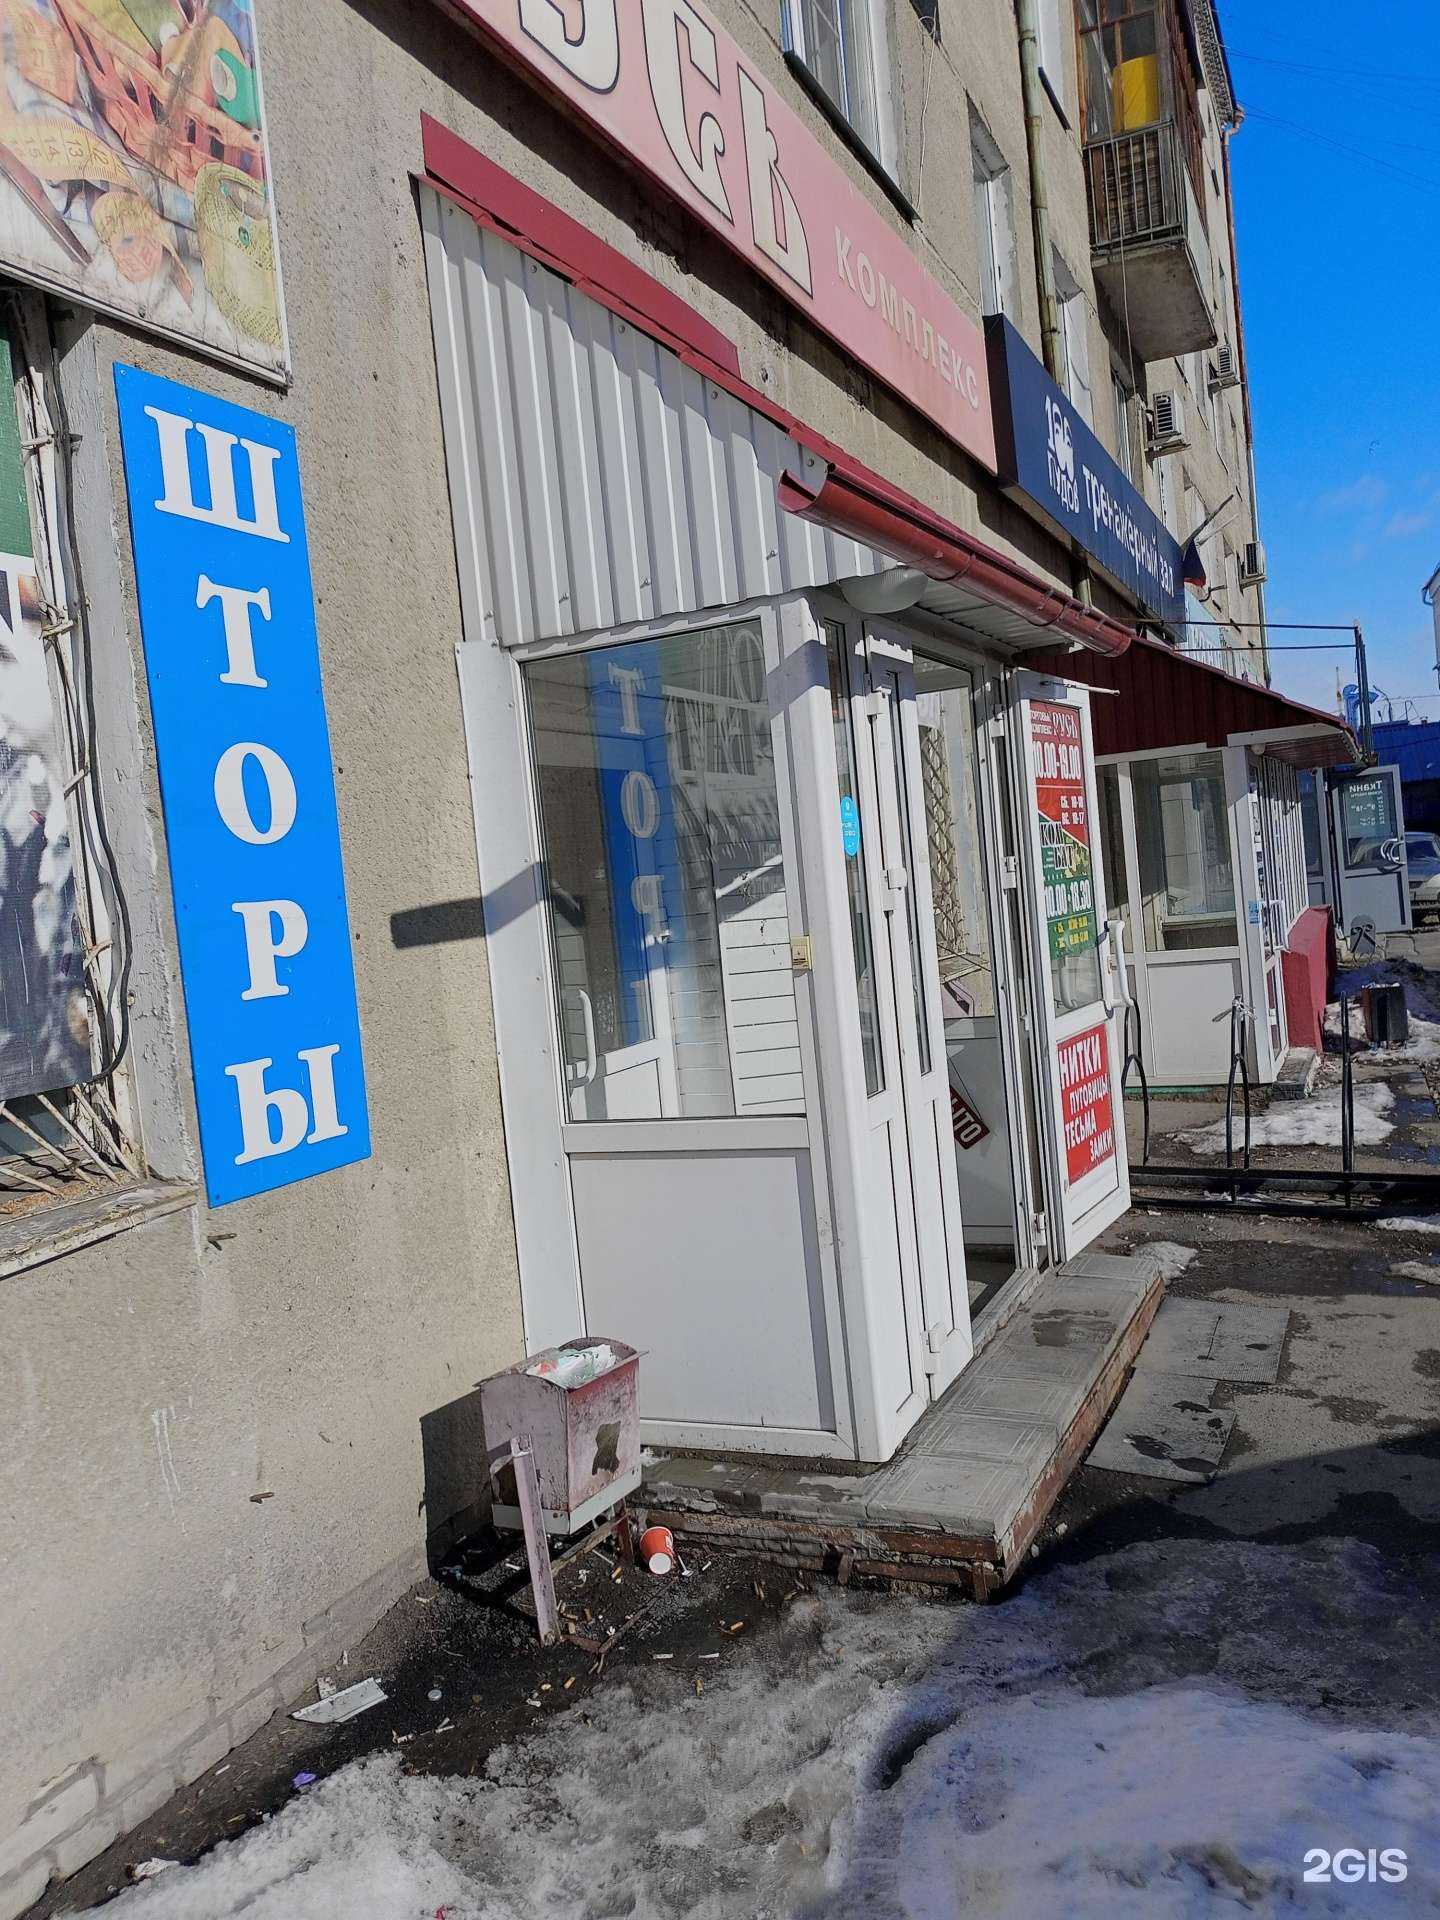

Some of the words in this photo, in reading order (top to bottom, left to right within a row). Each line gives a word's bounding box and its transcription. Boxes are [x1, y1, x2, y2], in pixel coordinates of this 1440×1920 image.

[834, 224, 978, 409] КОМПЛЕКС
[144, 405, 349, 1167] ШТОРЫ
[1059, 1034, 1101, 1089] НИТКИ
[1070, 1074, 1111, 1115] ПУГОВИЦЫ
[1065, 1108, 1096, 1150] ТЕСЬМА
[1090, 1131, 1113, 1162] ЗАМКИ
